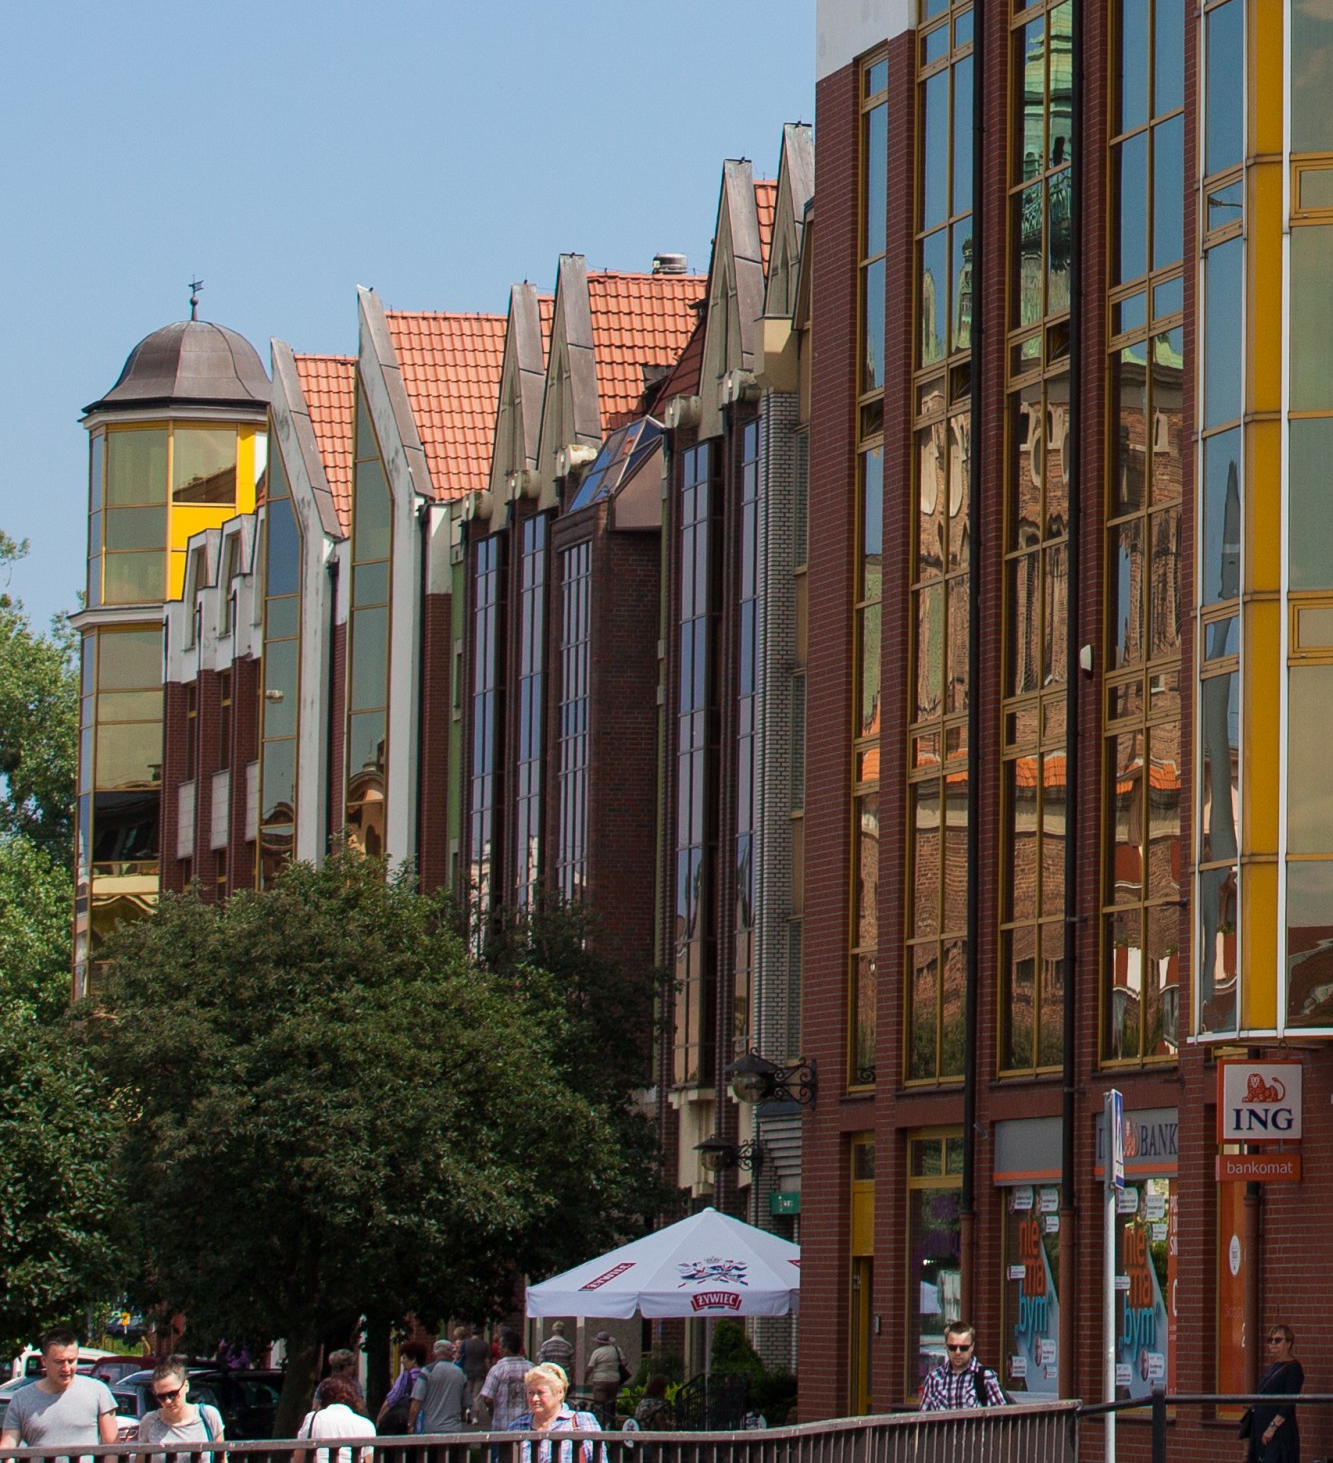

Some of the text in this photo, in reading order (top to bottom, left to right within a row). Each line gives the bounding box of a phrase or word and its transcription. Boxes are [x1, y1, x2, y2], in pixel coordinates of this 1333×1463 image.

[1232, 1108, 1294, 1131] ING
[1140, 1123, 1178, 1157] BANK
[1227, 1161, 1293, 1174] bankomat
[1019, 1210, 1040, 1256] nie
[1124, 1215, 1145, 1265] nie
[1023, 1257, 1045, 1294] ma
[1128, 1268, 1152, 1305] ma
[697, 1293, 737, 1307] ŻYWIEC
